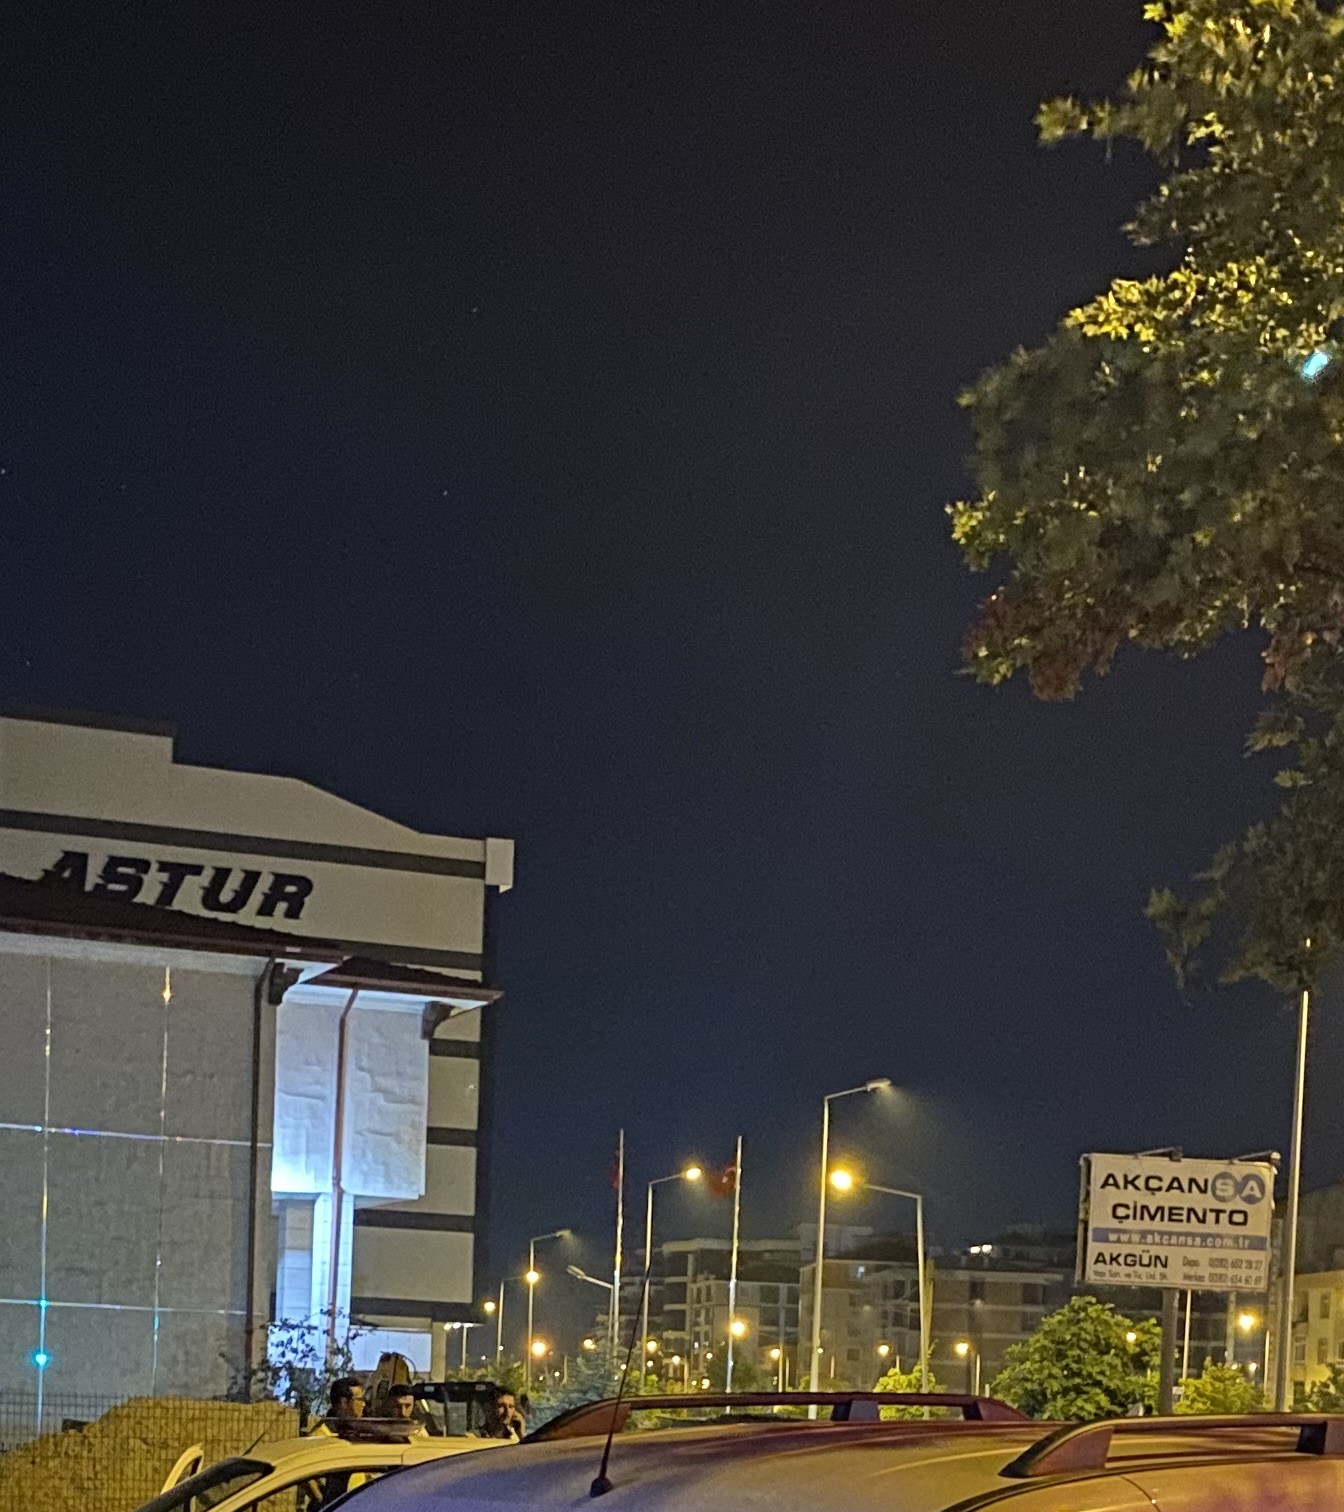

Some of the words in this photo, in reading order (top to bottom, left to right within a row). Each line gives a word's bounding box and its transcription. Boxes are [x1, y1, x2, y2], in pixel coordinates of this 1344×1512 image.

[40, 850, 314, 920] ASTUR
[1112, 1201, 1249, 1227] ÇİMENTO
[1108, 1231, 1250, 1249] www.akcansa.com.tr
[1093, 1249, 1169, 1269] AKGÜN
